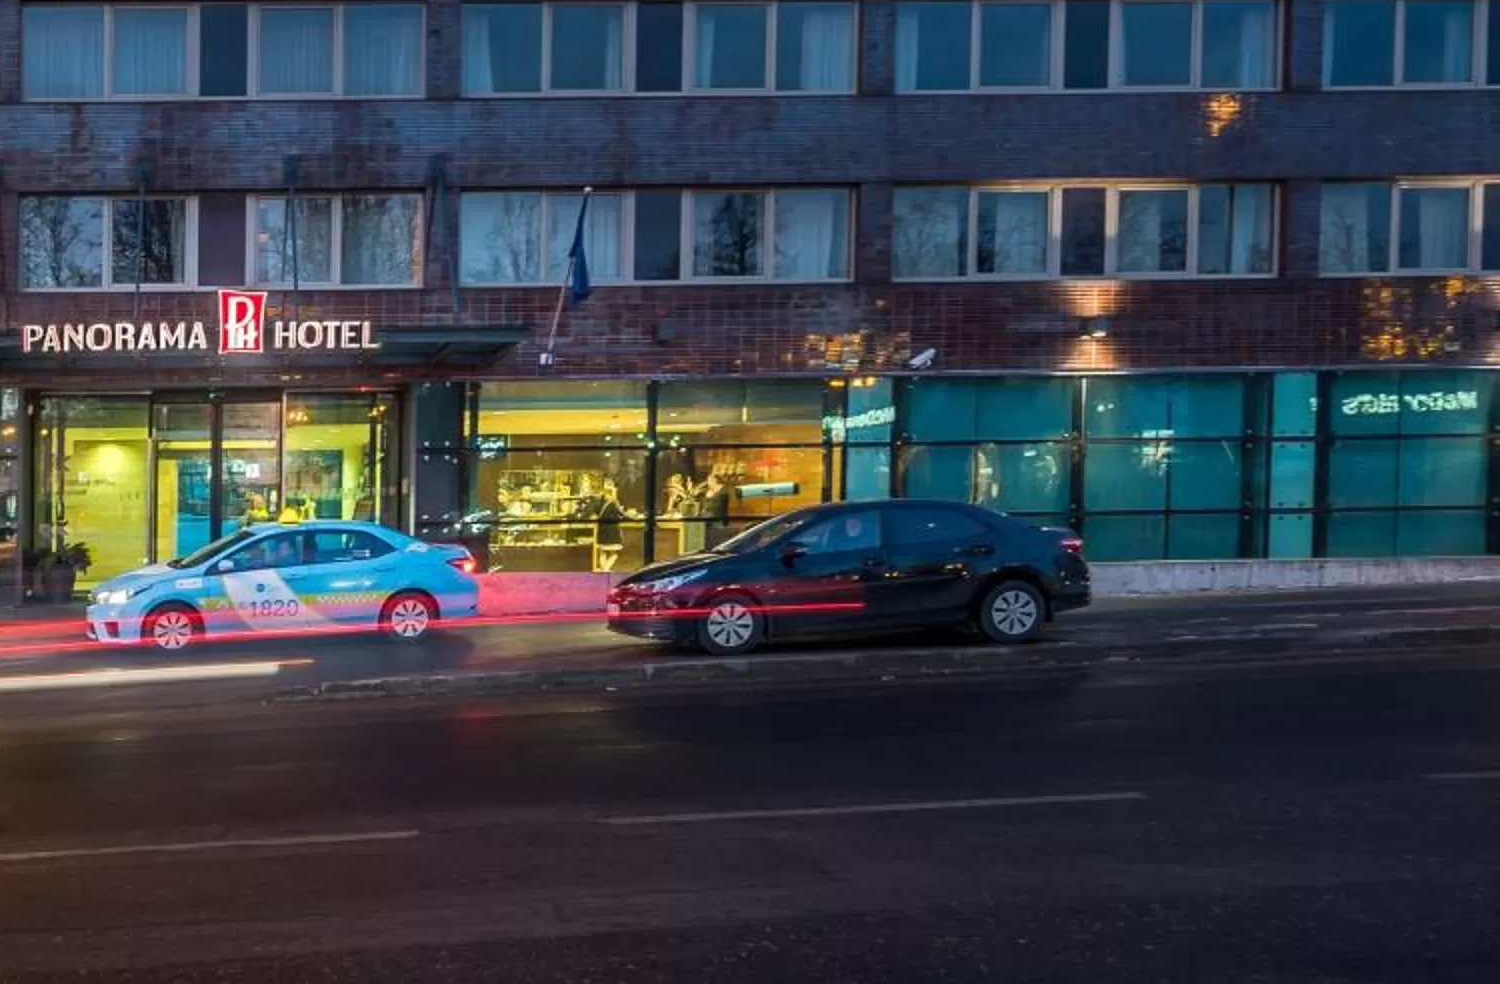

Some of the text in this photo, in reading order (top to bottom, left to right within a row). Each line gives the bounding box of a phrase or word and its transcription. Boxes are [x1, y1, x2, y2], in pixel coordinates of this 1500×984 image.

[22, 322, 208, 352] PANORAMA
[275, 320, 382, 350] HOTEL
[249, 599, 299, 617] 1820
